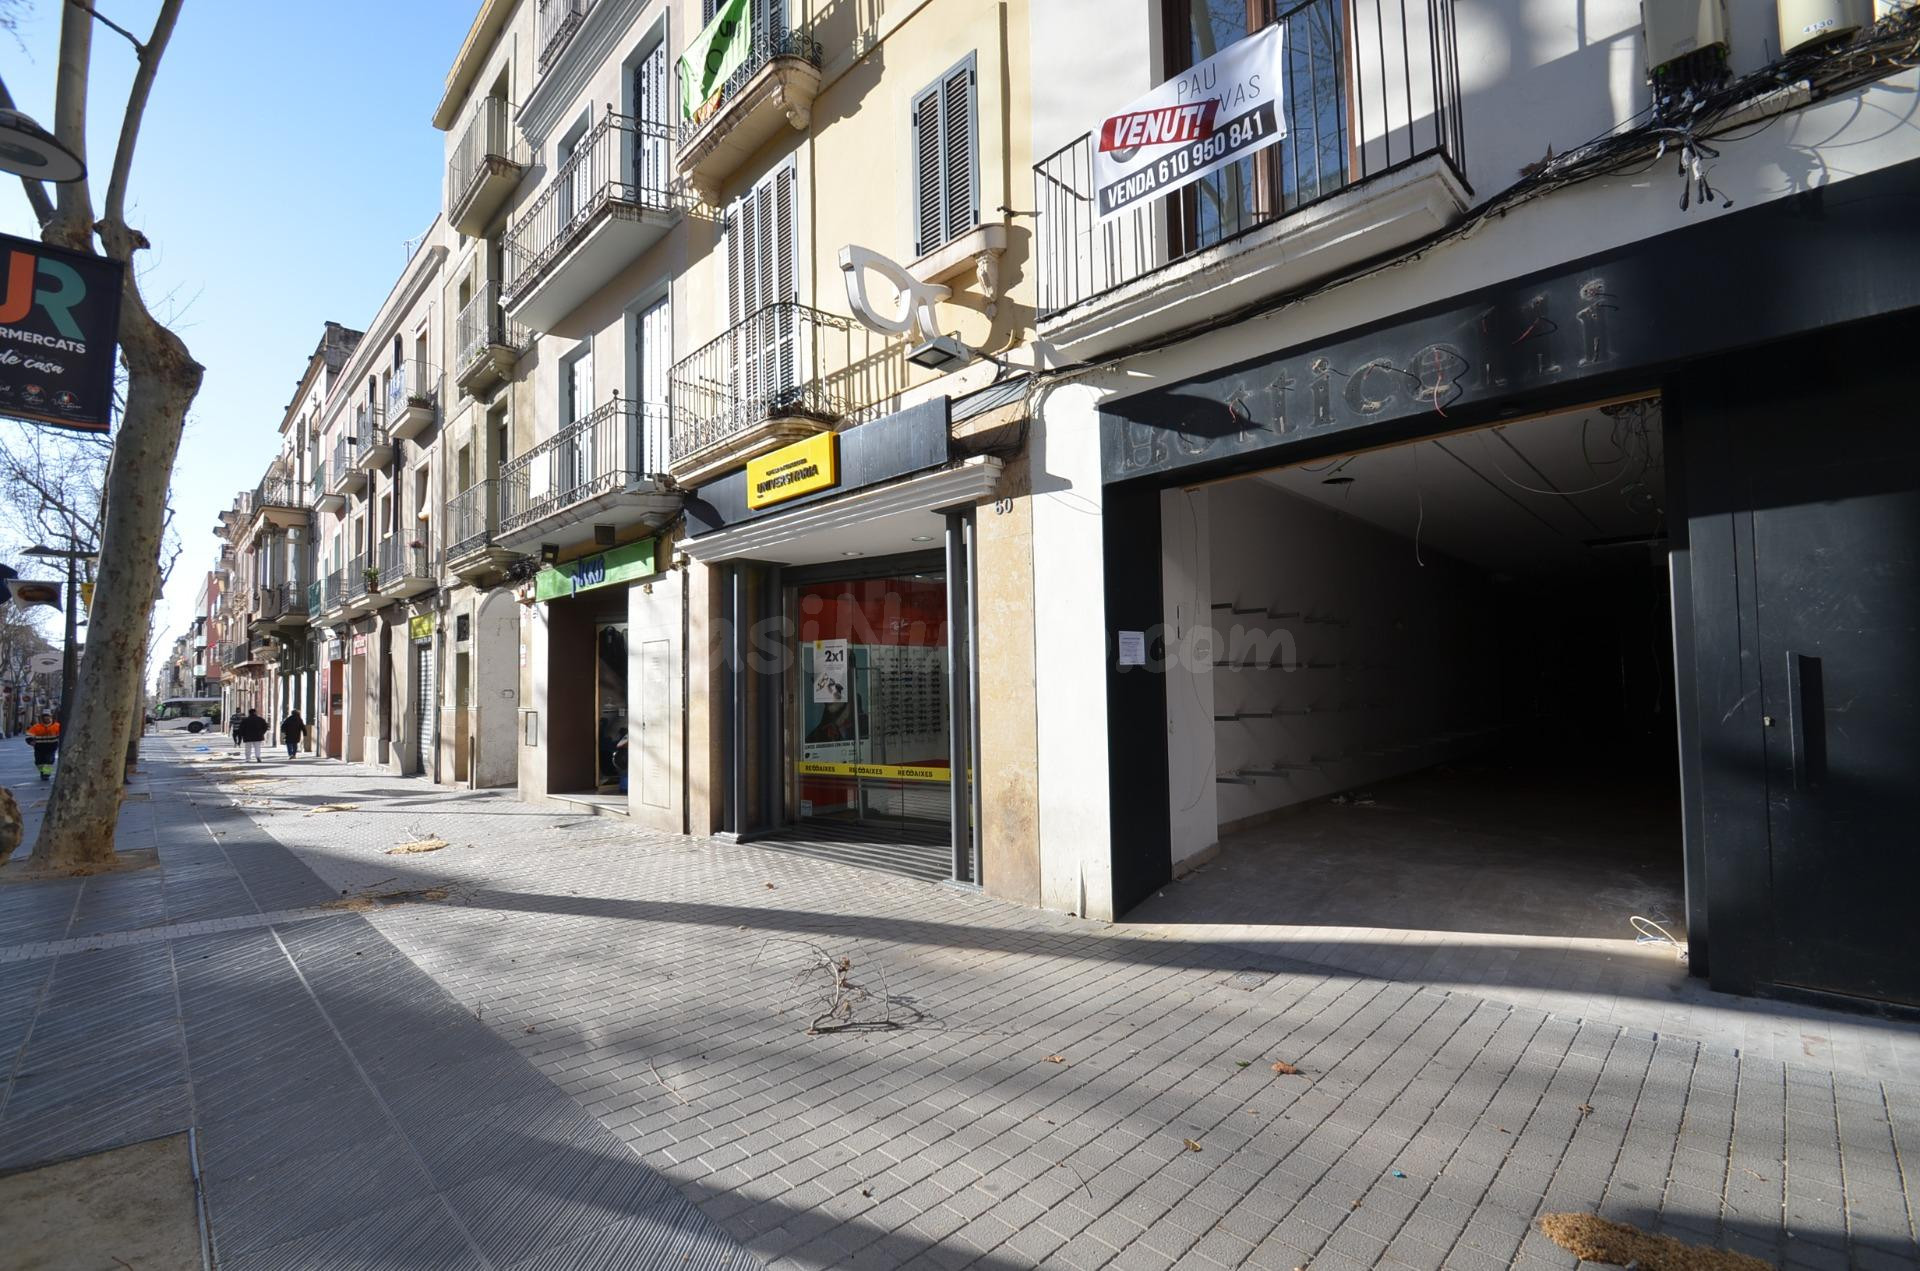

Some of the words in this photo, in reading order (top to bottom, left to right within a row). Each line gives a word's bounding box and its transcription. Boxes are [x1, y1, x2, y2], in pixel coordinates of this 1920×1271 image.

[1177, 62, 1218, 105] PAU
[1113, 103, 1207, 148] VENUT!
[1107, 167, 1156, 208] VENDA
[1158, 153, 1190, 183] 610
[1192, 131, 1226, 167] 950
[1229, 110, 1264, 149] 841
[23, 358, 65, 375] casa
[824, 649, 844, 663] 2x1
